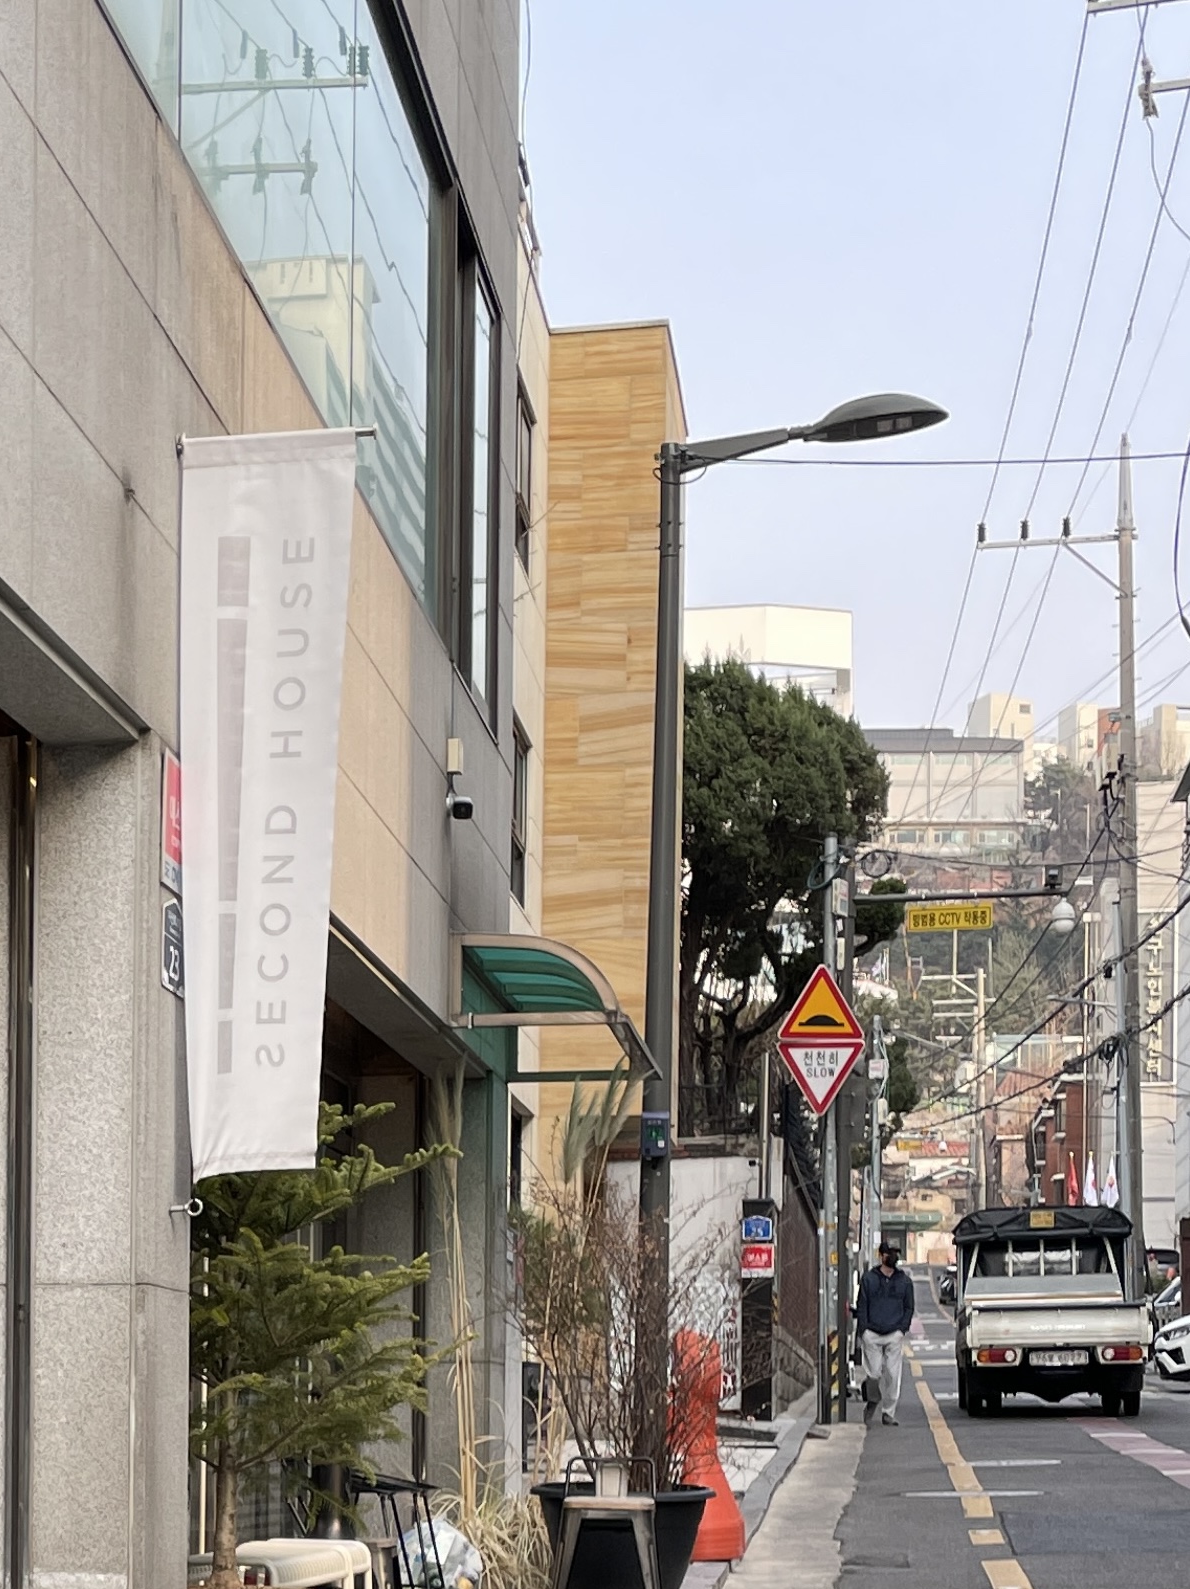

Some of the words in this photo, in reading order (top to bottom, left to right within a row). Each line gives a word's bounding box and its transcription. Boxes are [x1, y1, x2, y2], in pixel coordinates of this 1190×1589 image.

[270, 536, 316, 759] HOUSE
[938, 912, 961, 926] CCTV
[254, 804, 298, 1070] SECOND
[803, 1050, 839, 1067] 천천히
[806, 1067, 836, 1078] SLOW
